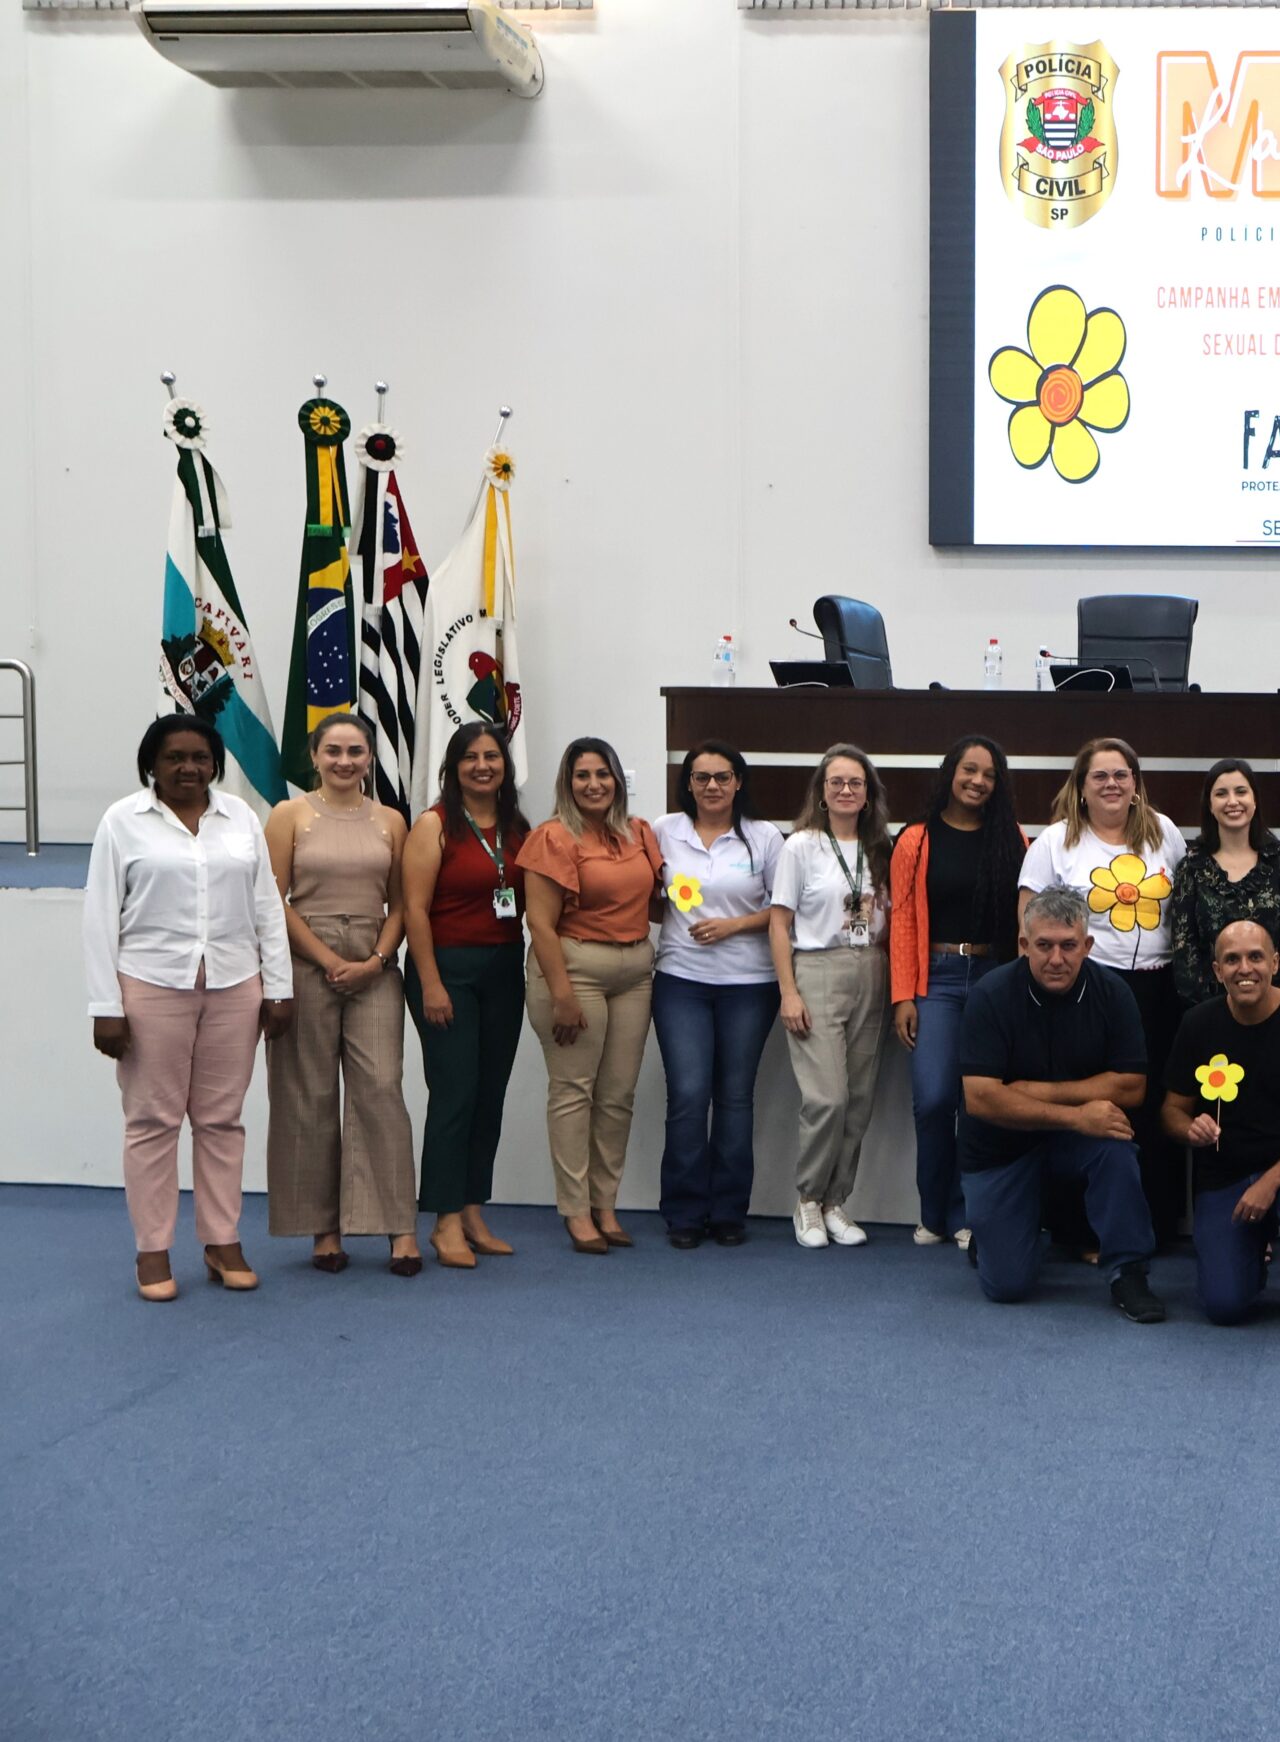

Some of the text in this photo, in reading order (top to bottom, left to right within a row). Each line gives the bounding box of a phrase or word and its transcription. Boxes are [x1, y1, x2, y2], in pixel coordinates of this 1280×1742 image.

[1024, 54, 1093, 79] POLÍCIA
[1055, 143, 1084, 160] PAULO
[1036, 178, 1086, 197] CIVIL
[1051, 208, 1069, 220] SP
[1158, 286, 1249, 309] CAMPANHA
[1258, 286, 1280, 309] EM
[1203, 334, 1266, 356] SEXUAL
[194, 597, 253, 680] CAPIVARI
[434, 614, 473, 725] ODER LEGISLATIVO
